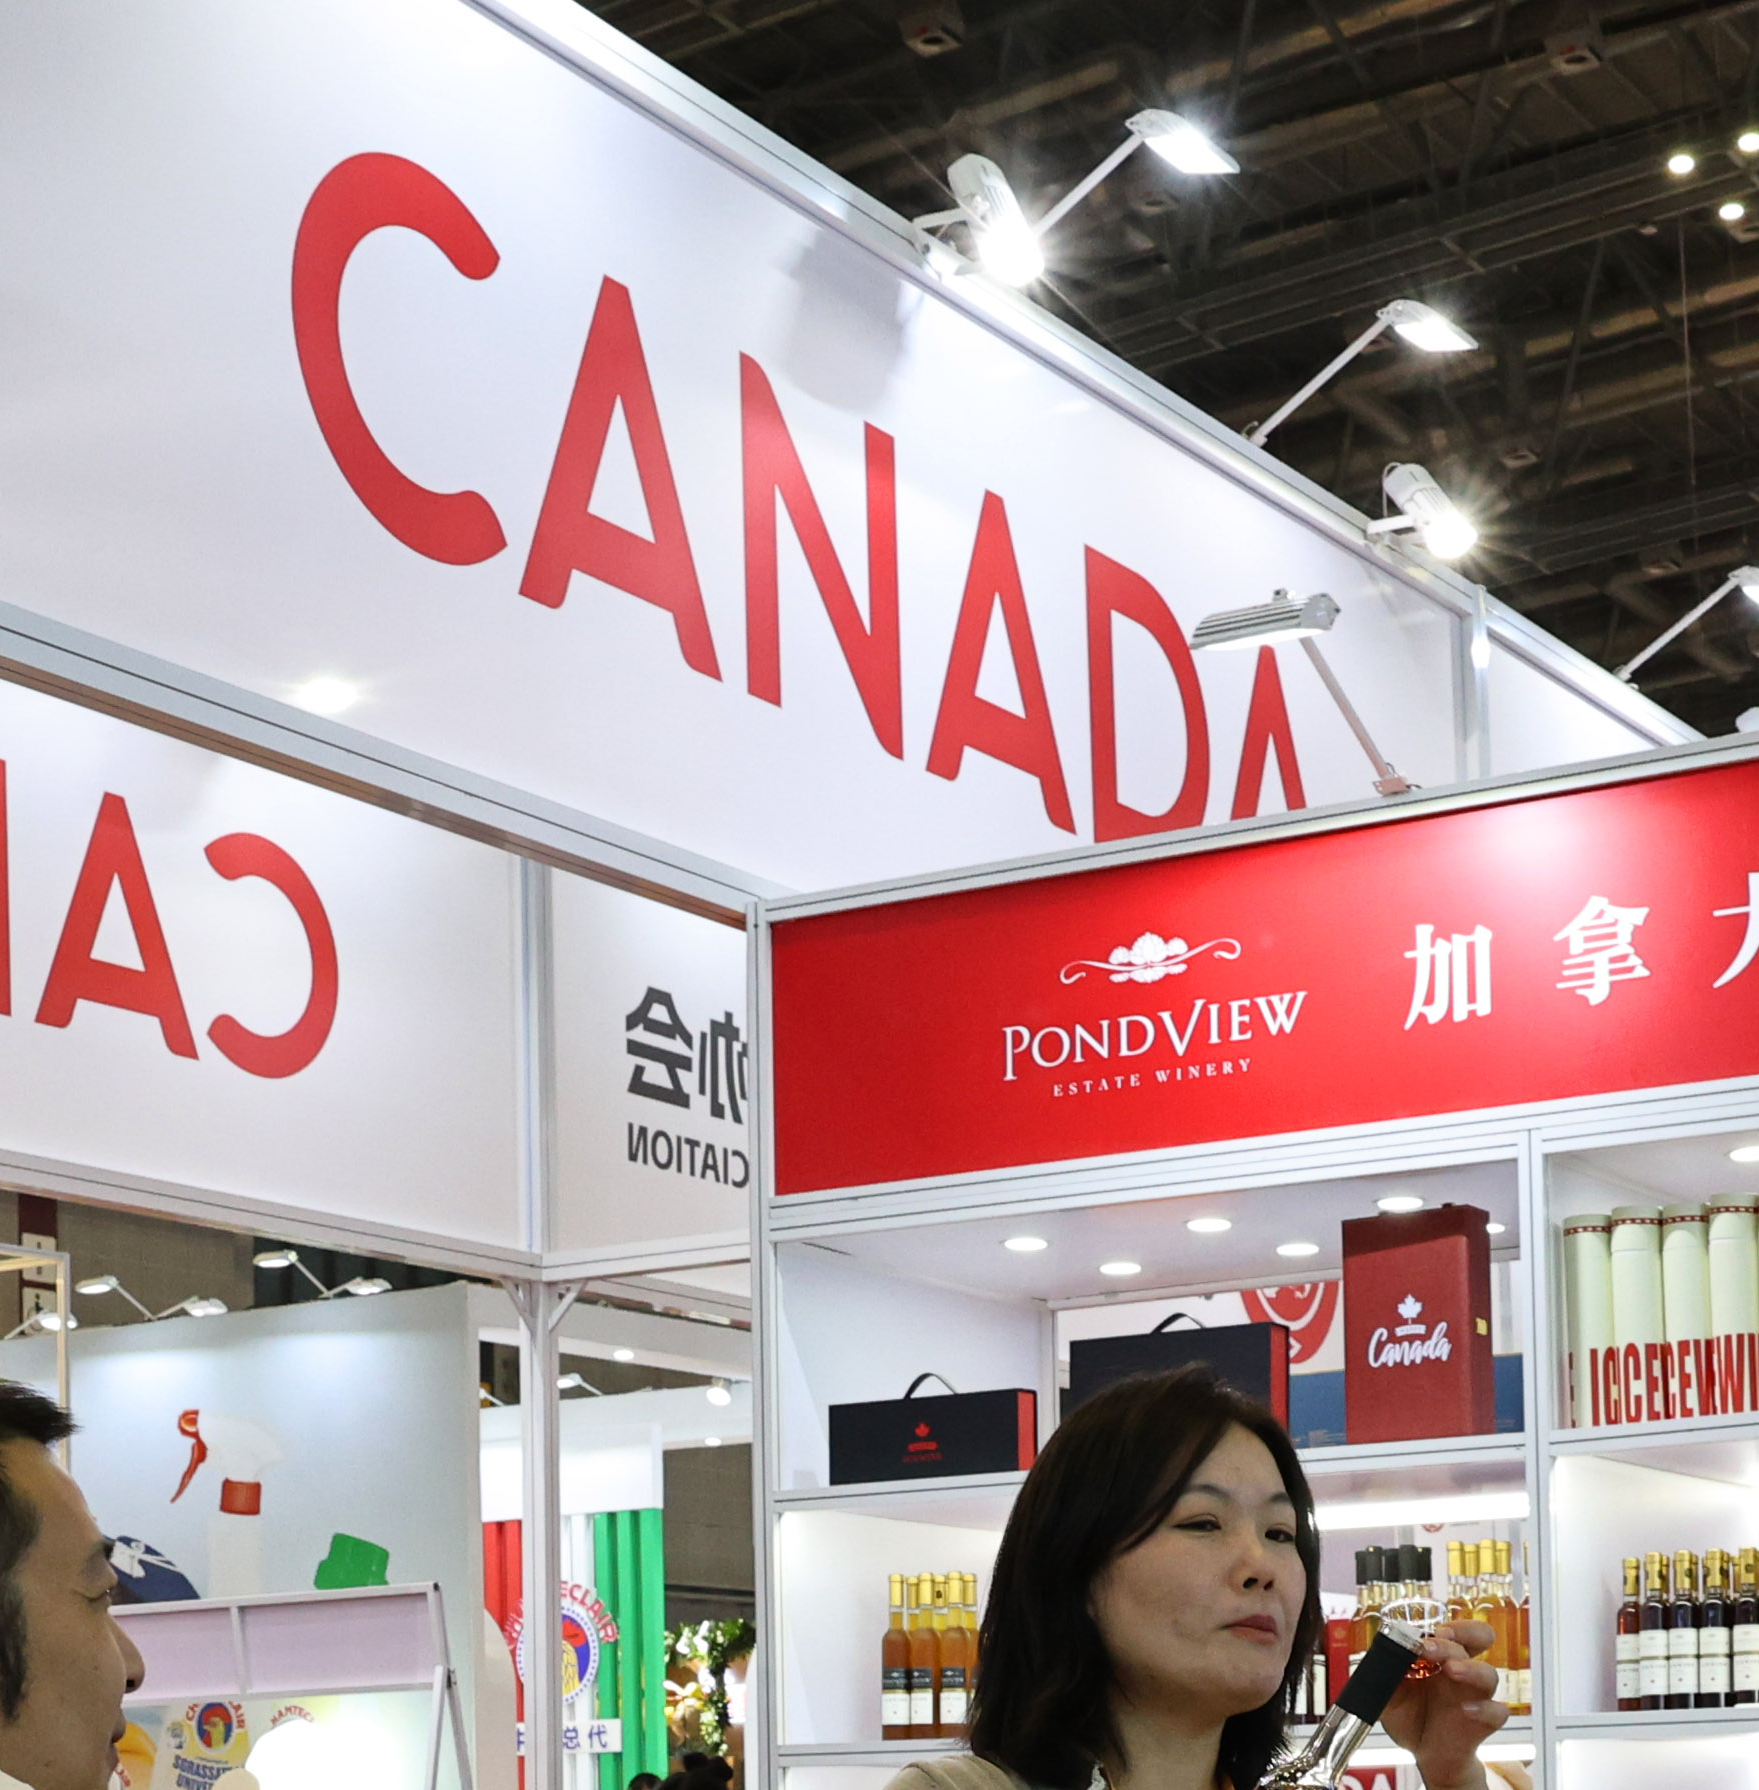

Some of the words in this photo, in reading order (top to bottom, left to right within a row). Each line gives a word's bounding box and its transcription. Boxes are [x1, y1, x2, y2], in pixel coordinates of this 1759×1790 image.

[291, 152, 1306, 843] CANADA
[1002, 991, 1308, 1082] PONDVIEW
[1053, 1072, 1141, 1098] ESTATE
[1156, 1056, 1253, 1084] WINERY
[1368, 1321, 1452, 1368] Canada
